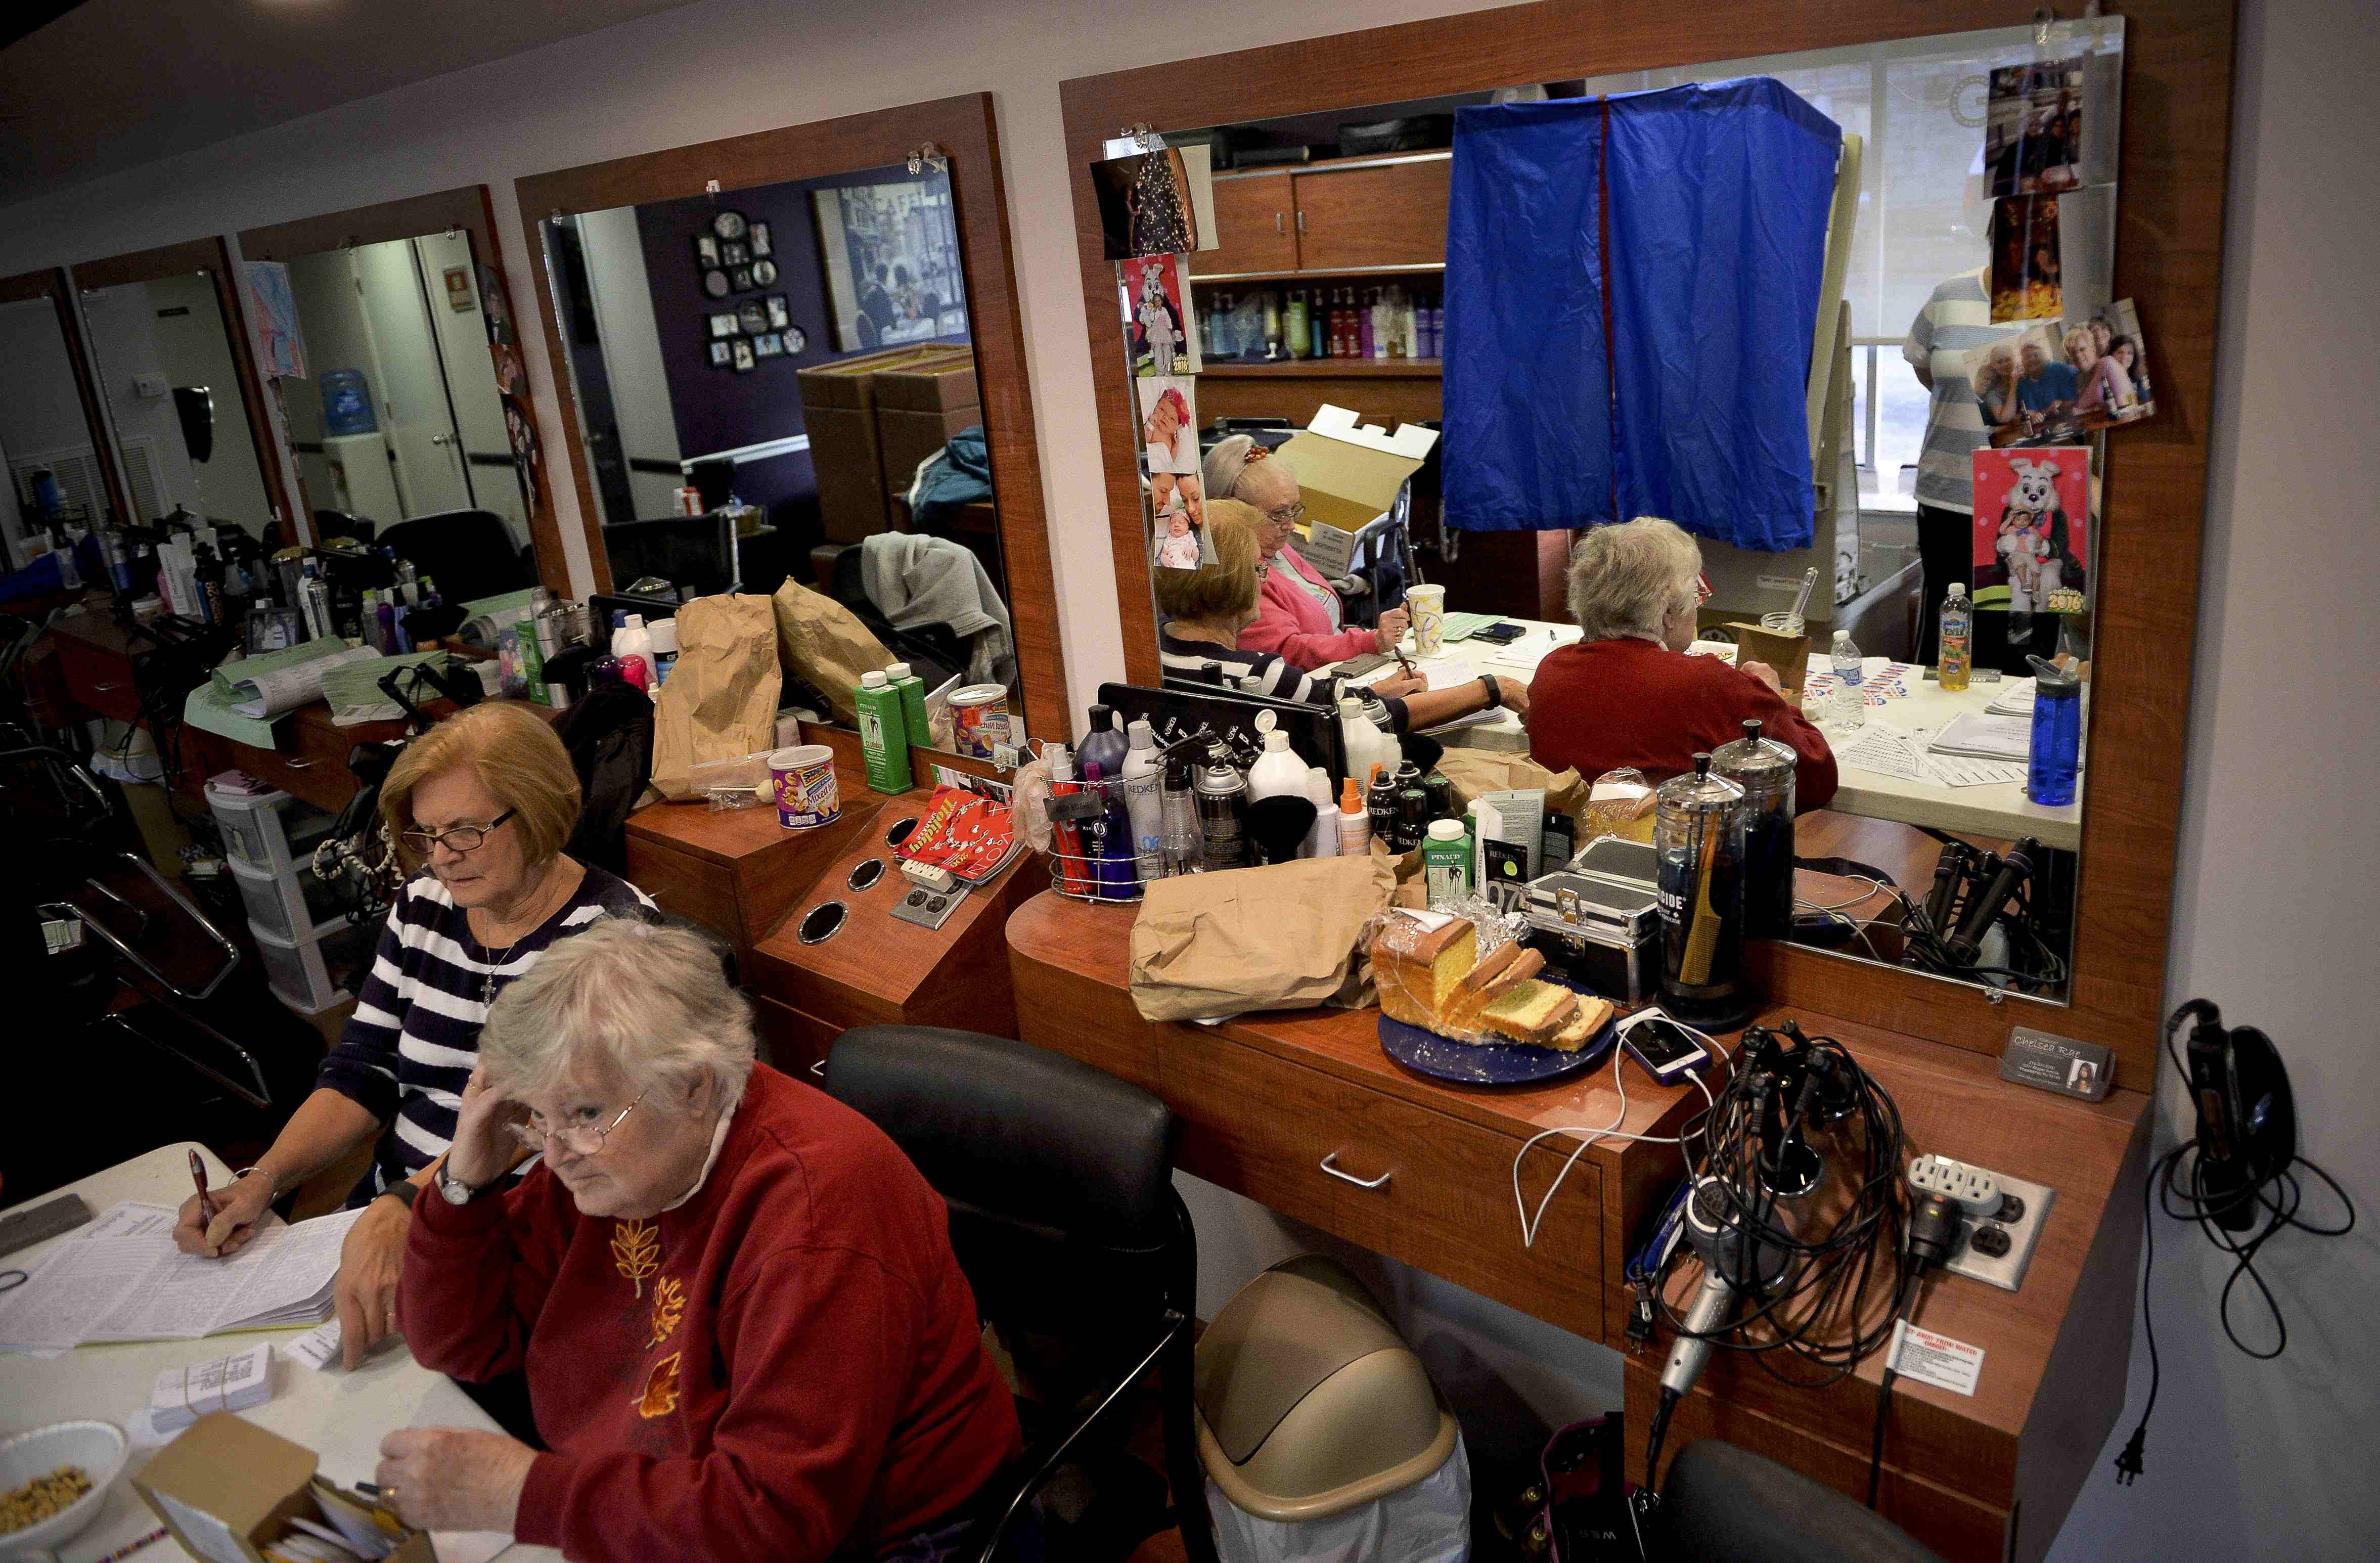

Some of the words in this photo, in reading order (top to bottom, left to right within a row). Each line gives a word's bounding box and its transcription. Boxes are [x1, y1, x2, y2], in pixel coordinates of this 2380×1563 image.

[2049, 595, 2082, 609] 2016
[806, 787, 829, 805] Mixed
[1369, 807, 1399, 816] REDKEN
[909, 797, 955, 854] Holiday
[915, 811, 938, 841] SPARKLE
[1490, 850, 1517, 861] REDKEN
[2014, 1036, 2055, 1052] Chelsea
[2059, 1046, 2080, 1058] Rae
[1917, 1330, 1934, 1341] AWAY
[1956, 1344, 1978, 1356] WATER
